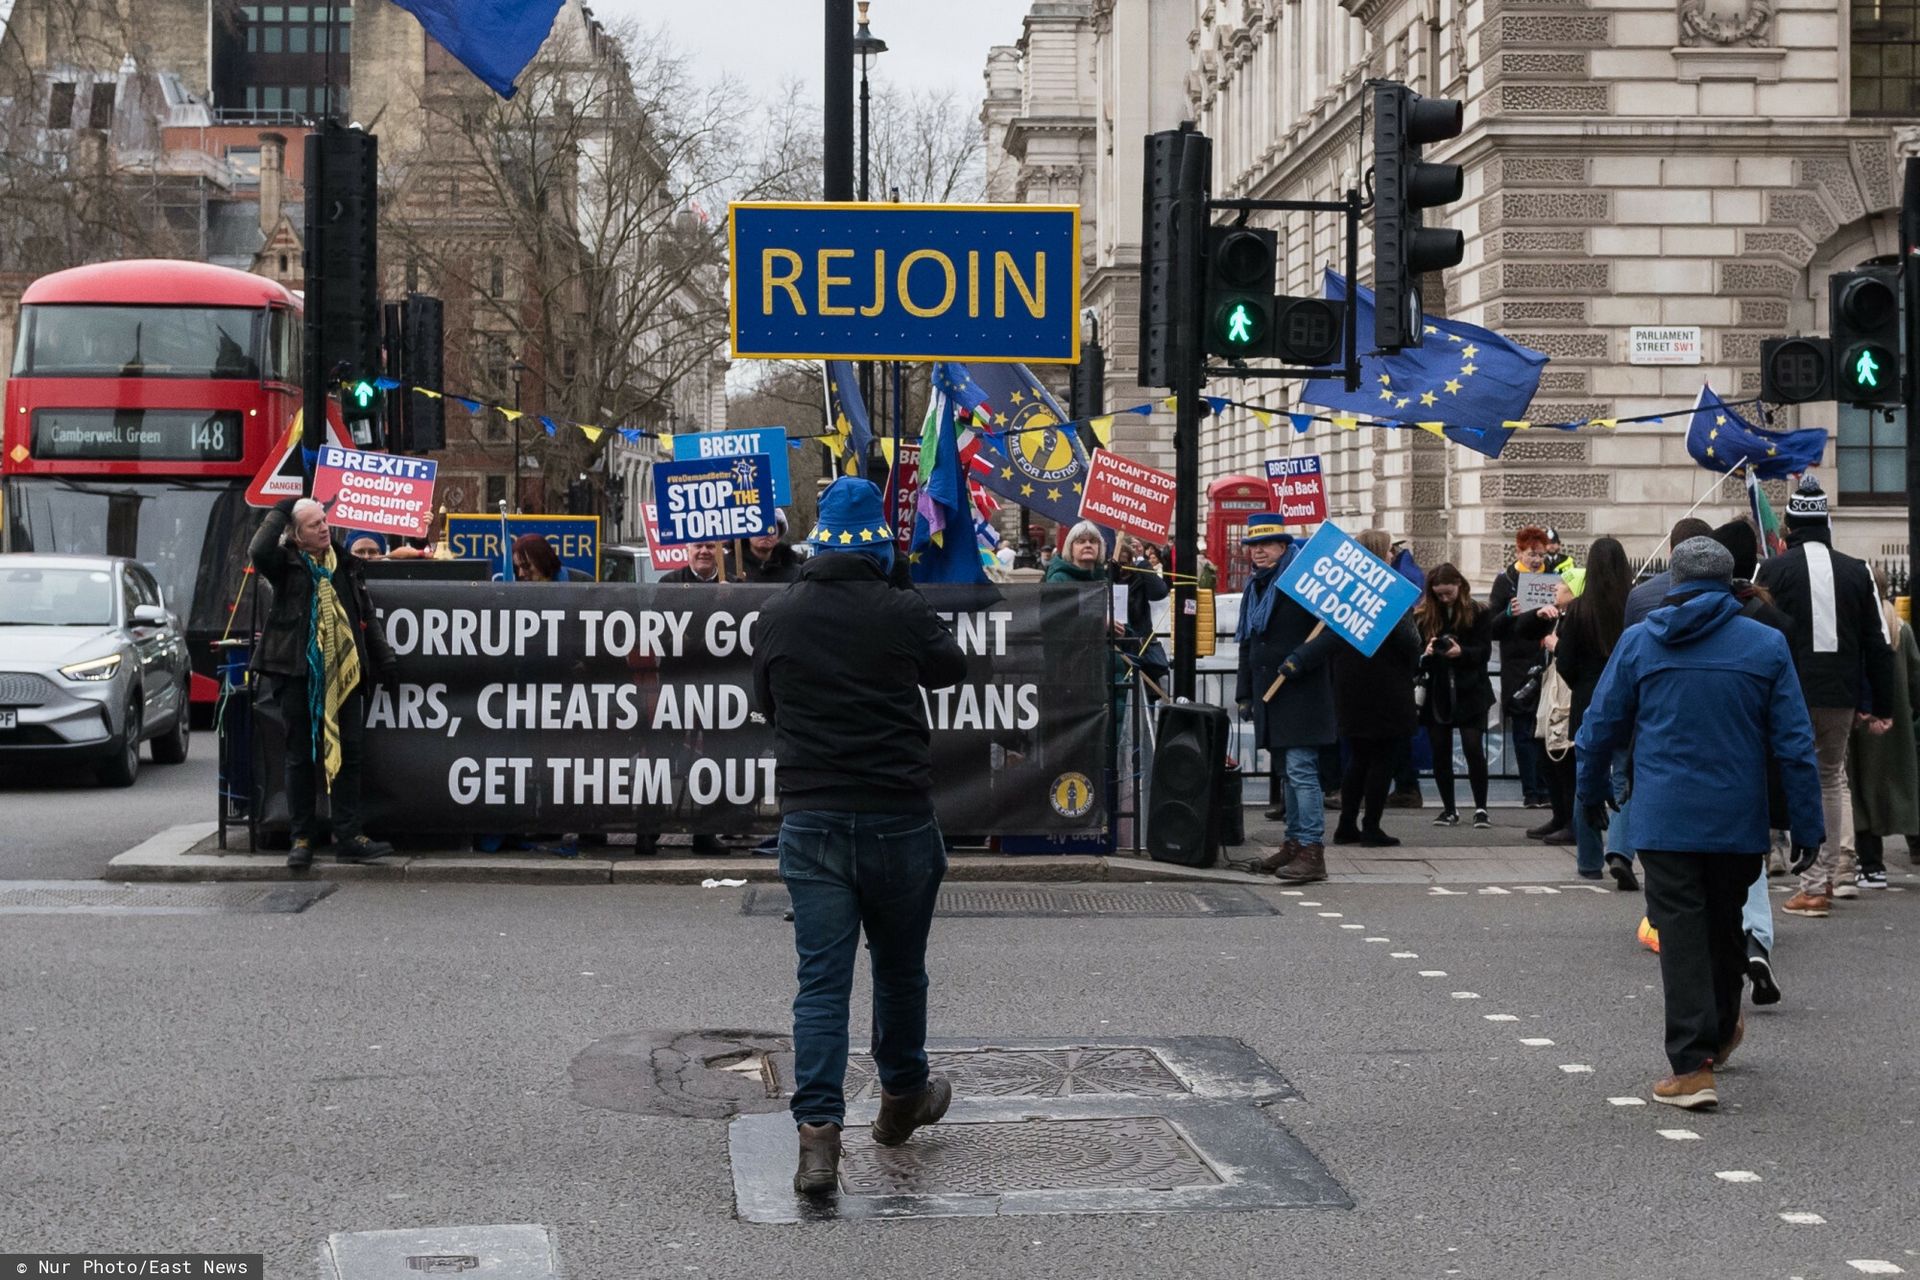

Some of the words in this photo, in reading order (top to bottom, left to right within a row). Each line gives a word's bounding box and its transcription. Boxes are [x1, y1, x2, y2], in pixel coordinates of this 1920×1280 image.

[762, 248, 1046, 318] REJOIN
[1636, 330, 1694, 340] PARLIAMENT
[1636, 342, 1669, 352] STREET
[1673, 342, 1694, 352] SW1
[51, 426, 122, 443] Camberwell
[126, 426, 161, 443] Green
[191, 421, 224, 450] 148
[699, 433, 761, 458] BREXIT
[326, 448, 428, 479] BREXIT:
[1018, 457, 1040, 477] FOR
[1042, 458, 1079, 479] ACTION
[1096, 453, 1118, 469] YOU
[1118, 462, 1150, 481] CAN'T
[1149, 474, 1176, 490] STOP
[1268, 460, 1298, 476] BREXIT
[1299, 459, 1317, 473] LIE:
[341, 472, 414, 495] Goodbye
[667, 480, 733, 512] STOP
[732, 489, 761, 505] THE
[1096, 471, 1104, 481] A
[1105, 473, 1134, 491] TORY
[1133, 484, 1169, 504] BREXIT
[1272, 482, 1294, 497] Take
[1294, 479, 1319, 496] Back
[338, 488, 423, 512] Consumer
[1112, 491, 1139, 509] WITH
[1139, 503, 1147, 513] A
[1282, 501, 1315, 517] Control
[335, 503, 420, 528] Standards
[670, 505, 763, 540] TORIES
[1085, 499, 1128, 522] LABOUR
[1128, 514, 1165, 535] BREXIT.
[453, 533, 592, 557] STRGER
[1333, 540, 1397, 593] BREXIT
[1313, 556, 1354, 592] GOT
[1349, 582, 1387, 619] THE
[1294, 572, 1326, 605] UK
[1319, 592, 1375, 641] DONE
[375, 608, 565, 657] ORRUPT
[578, 609, 694, 658] TORY
[361, 683, 462, 738] ARS,
[476, 683, 639, 730] CHEATS
[651, 684, 748, 730] AND
[447, 757, 532, 805] GET
[547, 757, 673, 805] THEM
[688, 757, 777, 806] OUT
